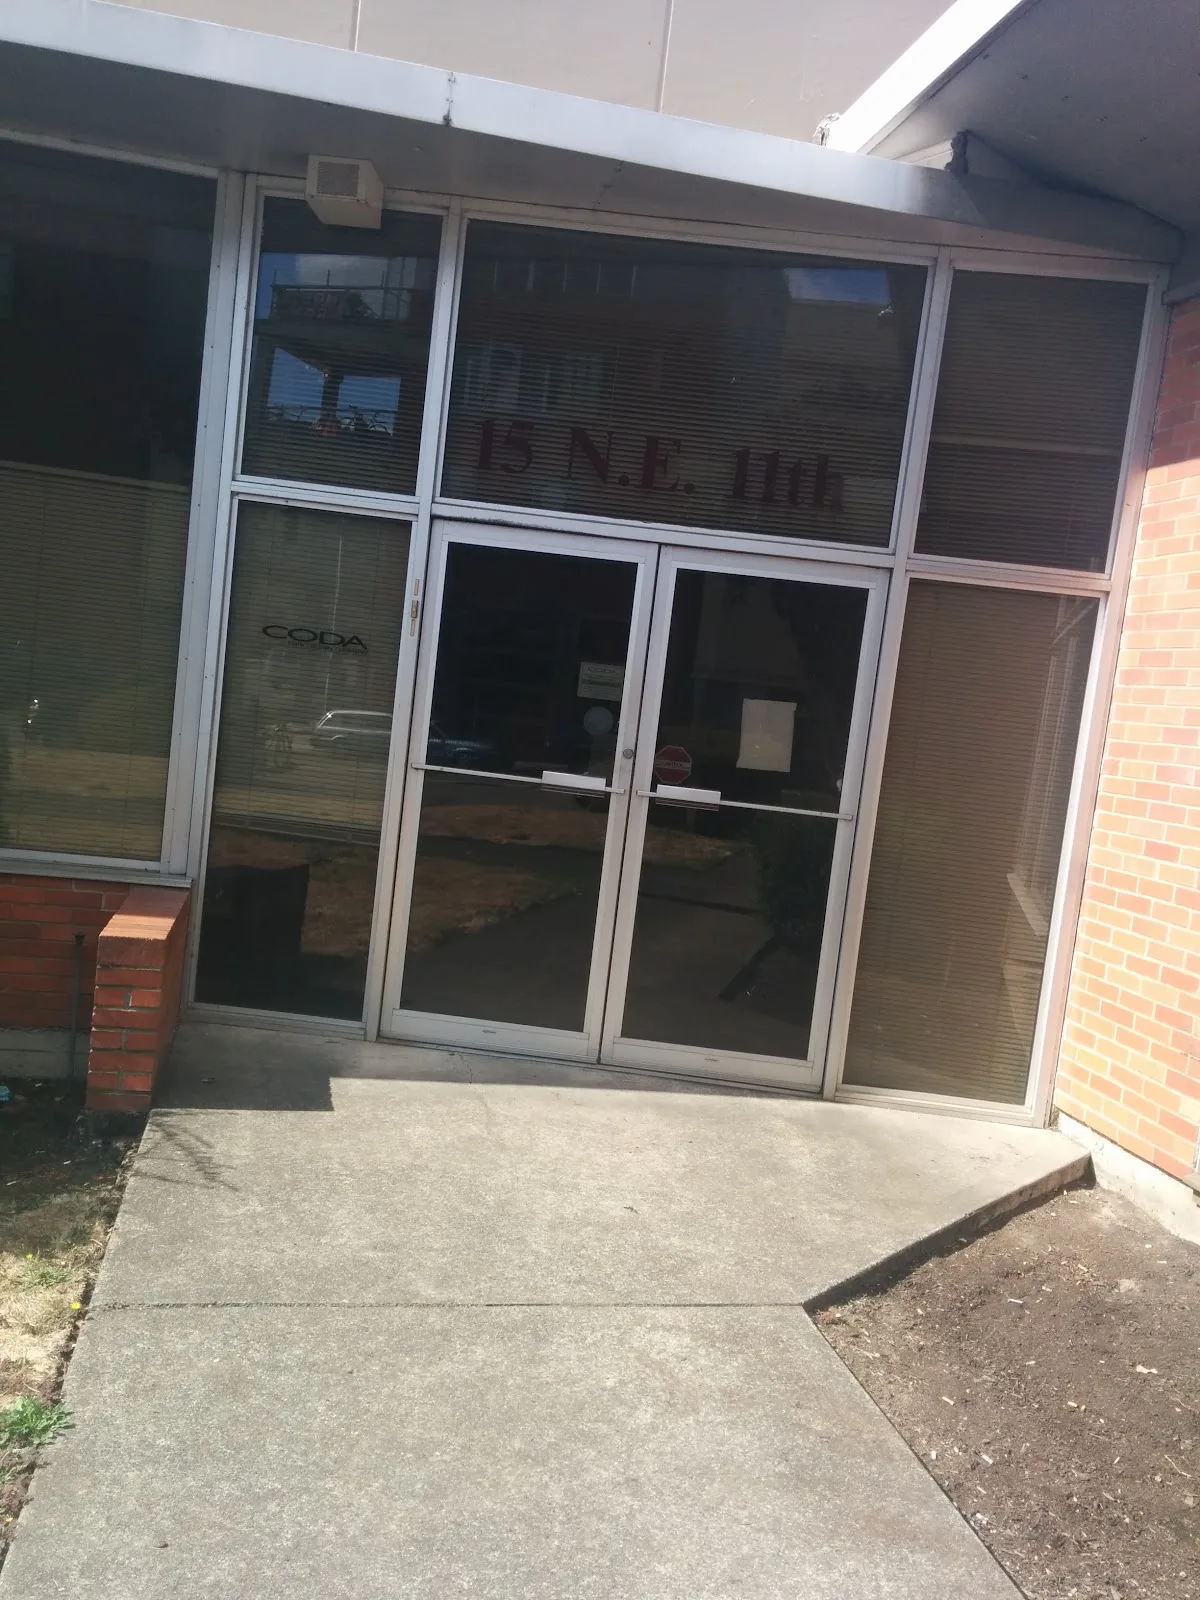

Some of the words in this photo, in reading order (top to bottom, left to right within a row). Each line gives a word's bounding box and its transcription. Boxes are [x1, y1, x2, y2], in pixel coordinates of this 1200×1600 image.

[478, 417, 534, 475] 15
[567, 426, 697, 495] N.E.
[733, 447, 846, 513] 11th
[262, 624, 368, 650] CODA
